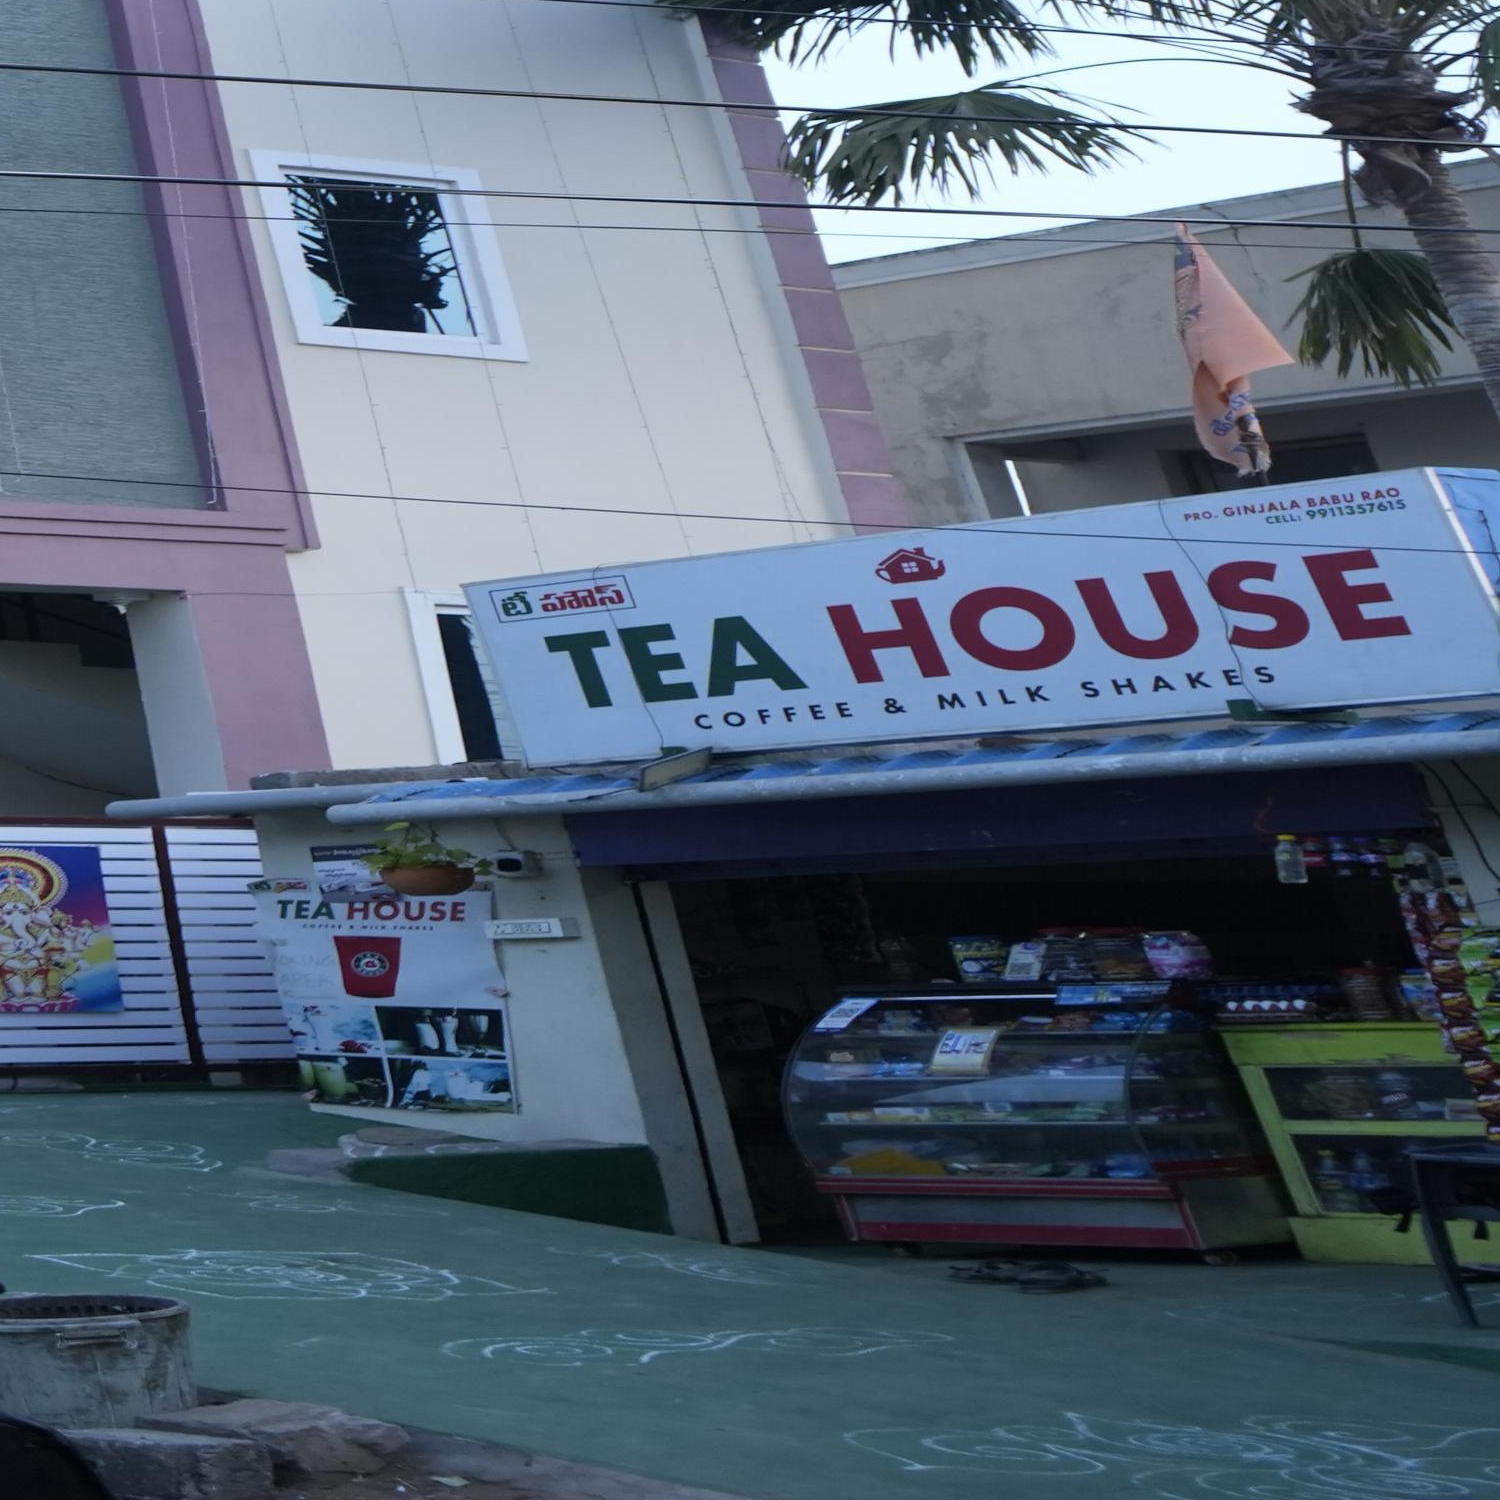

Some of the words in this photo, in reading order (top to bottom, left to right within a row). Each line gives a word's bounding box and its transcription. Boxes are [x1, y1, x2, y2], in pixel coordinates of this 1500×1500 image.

[1183, 509, 1218, 523] PRO.
[1222, 498, 1301, 518] GINJALA
[1306, 492, 1355, 509] BABU
[1361, 486, 1401, 502] RAO
[1265, 513, 1302, 525] CELL:
[1305, 498, 1407, 521] 9911357615
[543, 615, 809, 709] TEA
[826, 548, 1412, 683] HOUSE
[693, 701, 853, 731] COFFEE
[883, 697, 907, 715] &
[937, 685, 1051, 711] MILK
[1080, 665, 1276, 700] SHAKES
[276, 899, 337, 920] TEA
[346, 900, 467, 922] HOUSE
